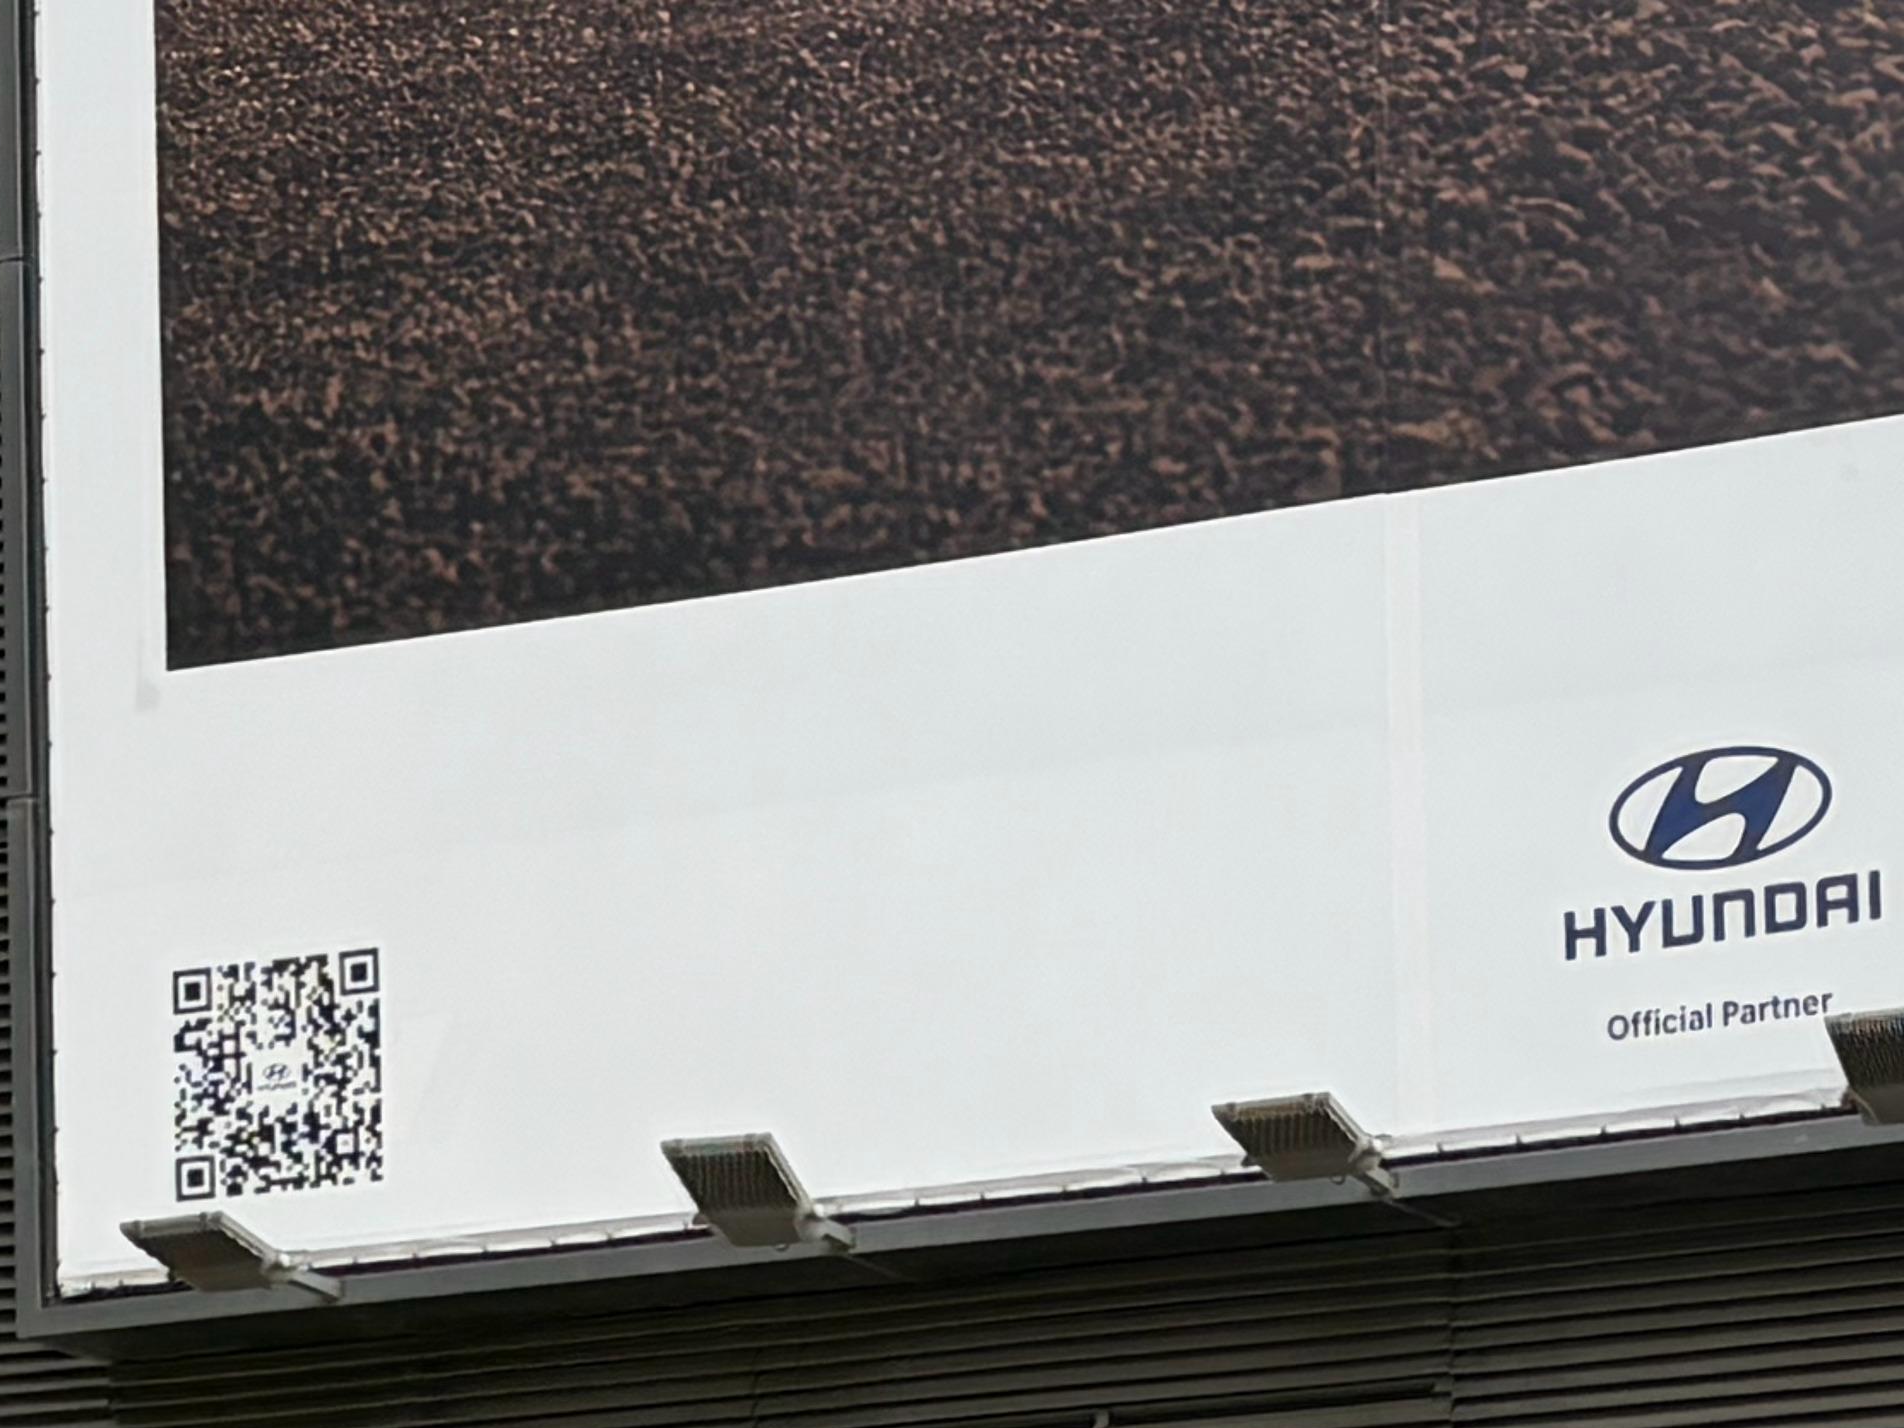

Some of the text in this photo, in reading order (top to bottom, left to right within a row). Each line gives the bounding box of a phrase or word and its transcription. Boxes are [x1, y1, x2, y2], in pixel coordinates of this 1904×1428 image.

[1563, 869, 1882, 961] HYUNDAI
[1607, 988, 1834, 1041] Official Partner
